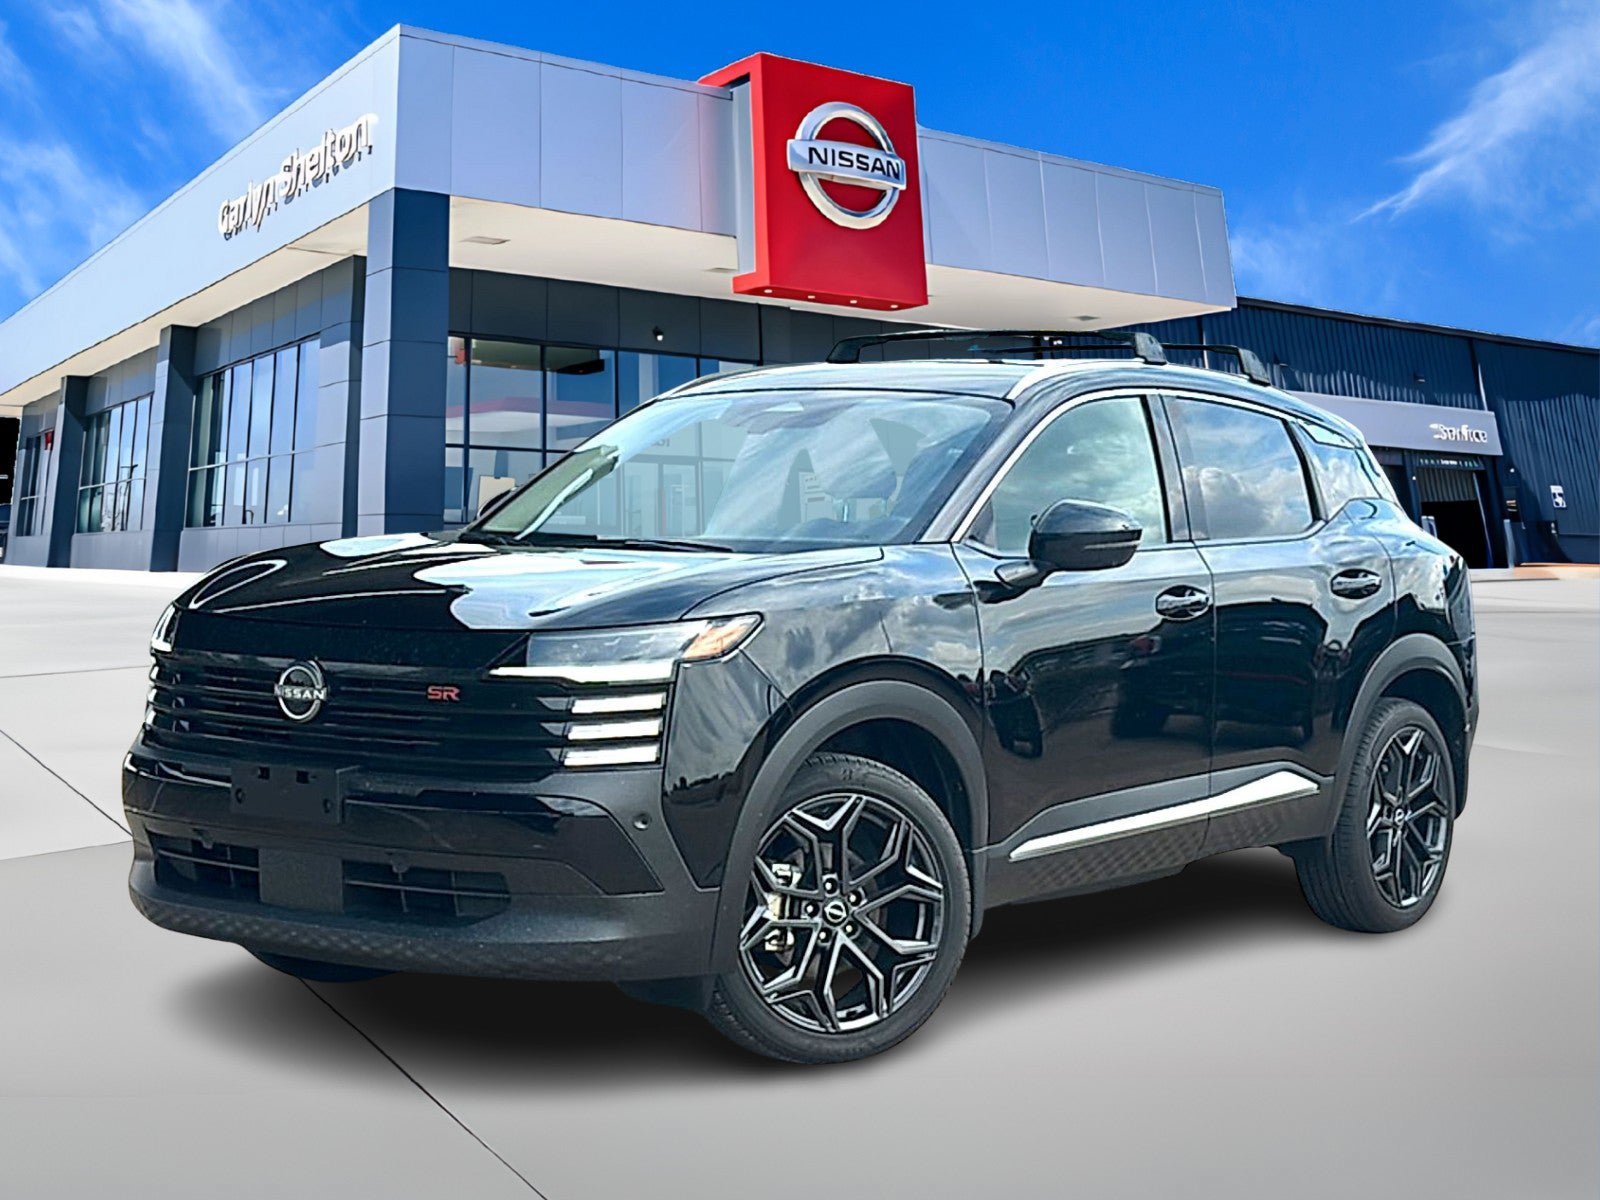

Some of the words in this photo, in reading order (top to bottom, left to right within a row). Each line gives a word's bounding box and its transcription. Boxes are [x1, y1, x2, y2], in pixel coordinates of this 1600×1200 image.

[279, 113, 377, 199] Shelton
[808, 147, 899, 180] NISSAN
[274, 684, 327, 700] NISSAN
[427, 685, 460, 701] SR
